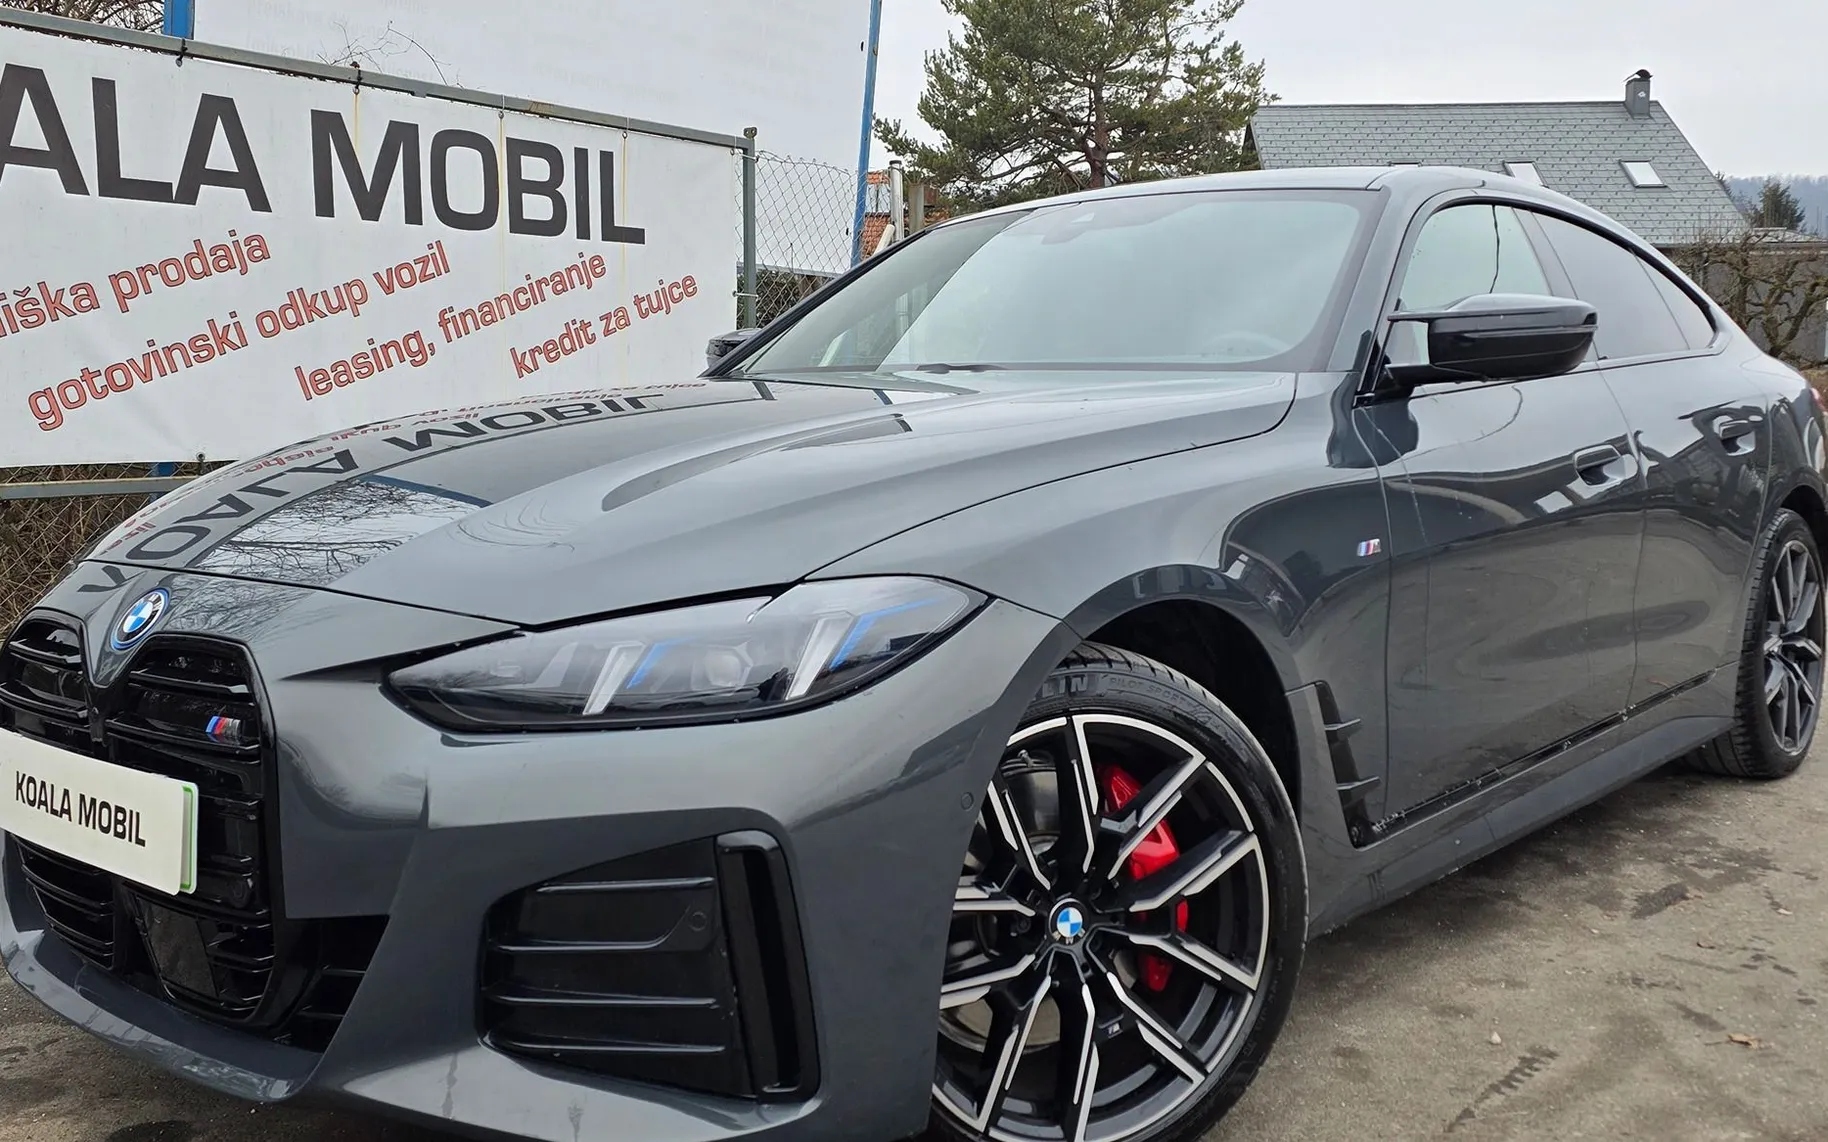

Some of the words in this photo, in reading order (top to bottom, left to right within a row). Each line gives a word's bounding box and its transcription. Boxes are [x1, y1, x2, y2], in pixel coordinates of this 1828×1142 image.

[311, 109, 645, 244] MOBIL
[0, 281, 101, 338] iška
[108, 229, 271, 313] prodaja
[28, 311, 249, 431] gotovinski
[256, 286, 369, 338] odkup
[373, 239, 451, 295] vozil
[294, 330, 436, 401] leasing,
[438, 251, 607, 343] financiranje
[510, 318, 597, 380] kredit
[599, 306, 632, 338] za
[633, 275, 698, 319] tujce
[16, 770, 72, 822] KOALA
[79, 793, 146, 847] MOBIL
